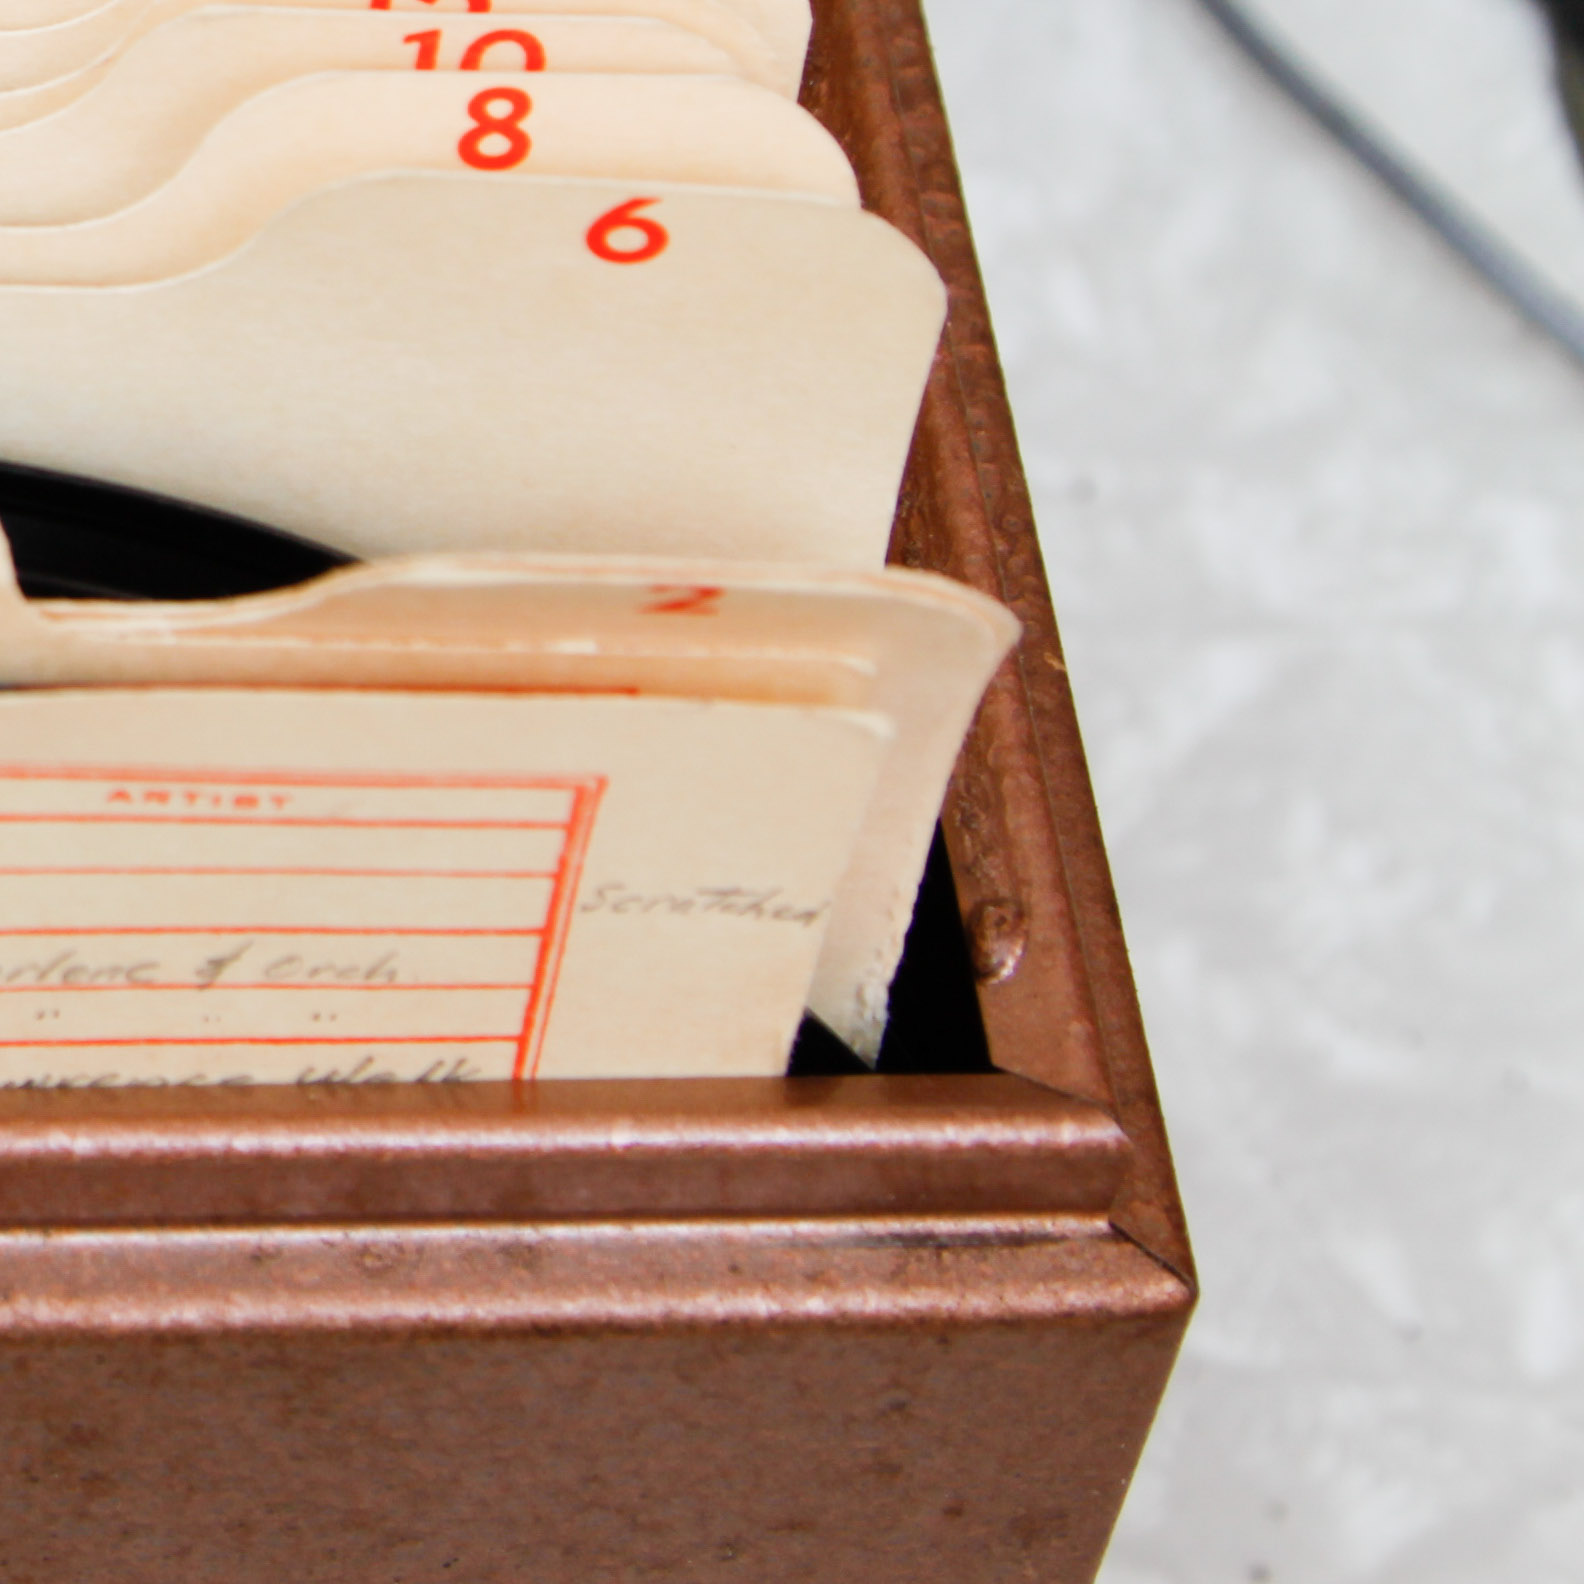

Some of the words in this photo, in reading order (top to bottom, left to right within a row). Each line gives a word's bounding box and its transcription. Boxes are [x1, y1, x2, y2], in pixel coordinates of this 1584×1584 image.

[455, 85, 534, 173] 8
[583, 196, 670, 266] 6
[106, 787, 296, 812] ARTIST
